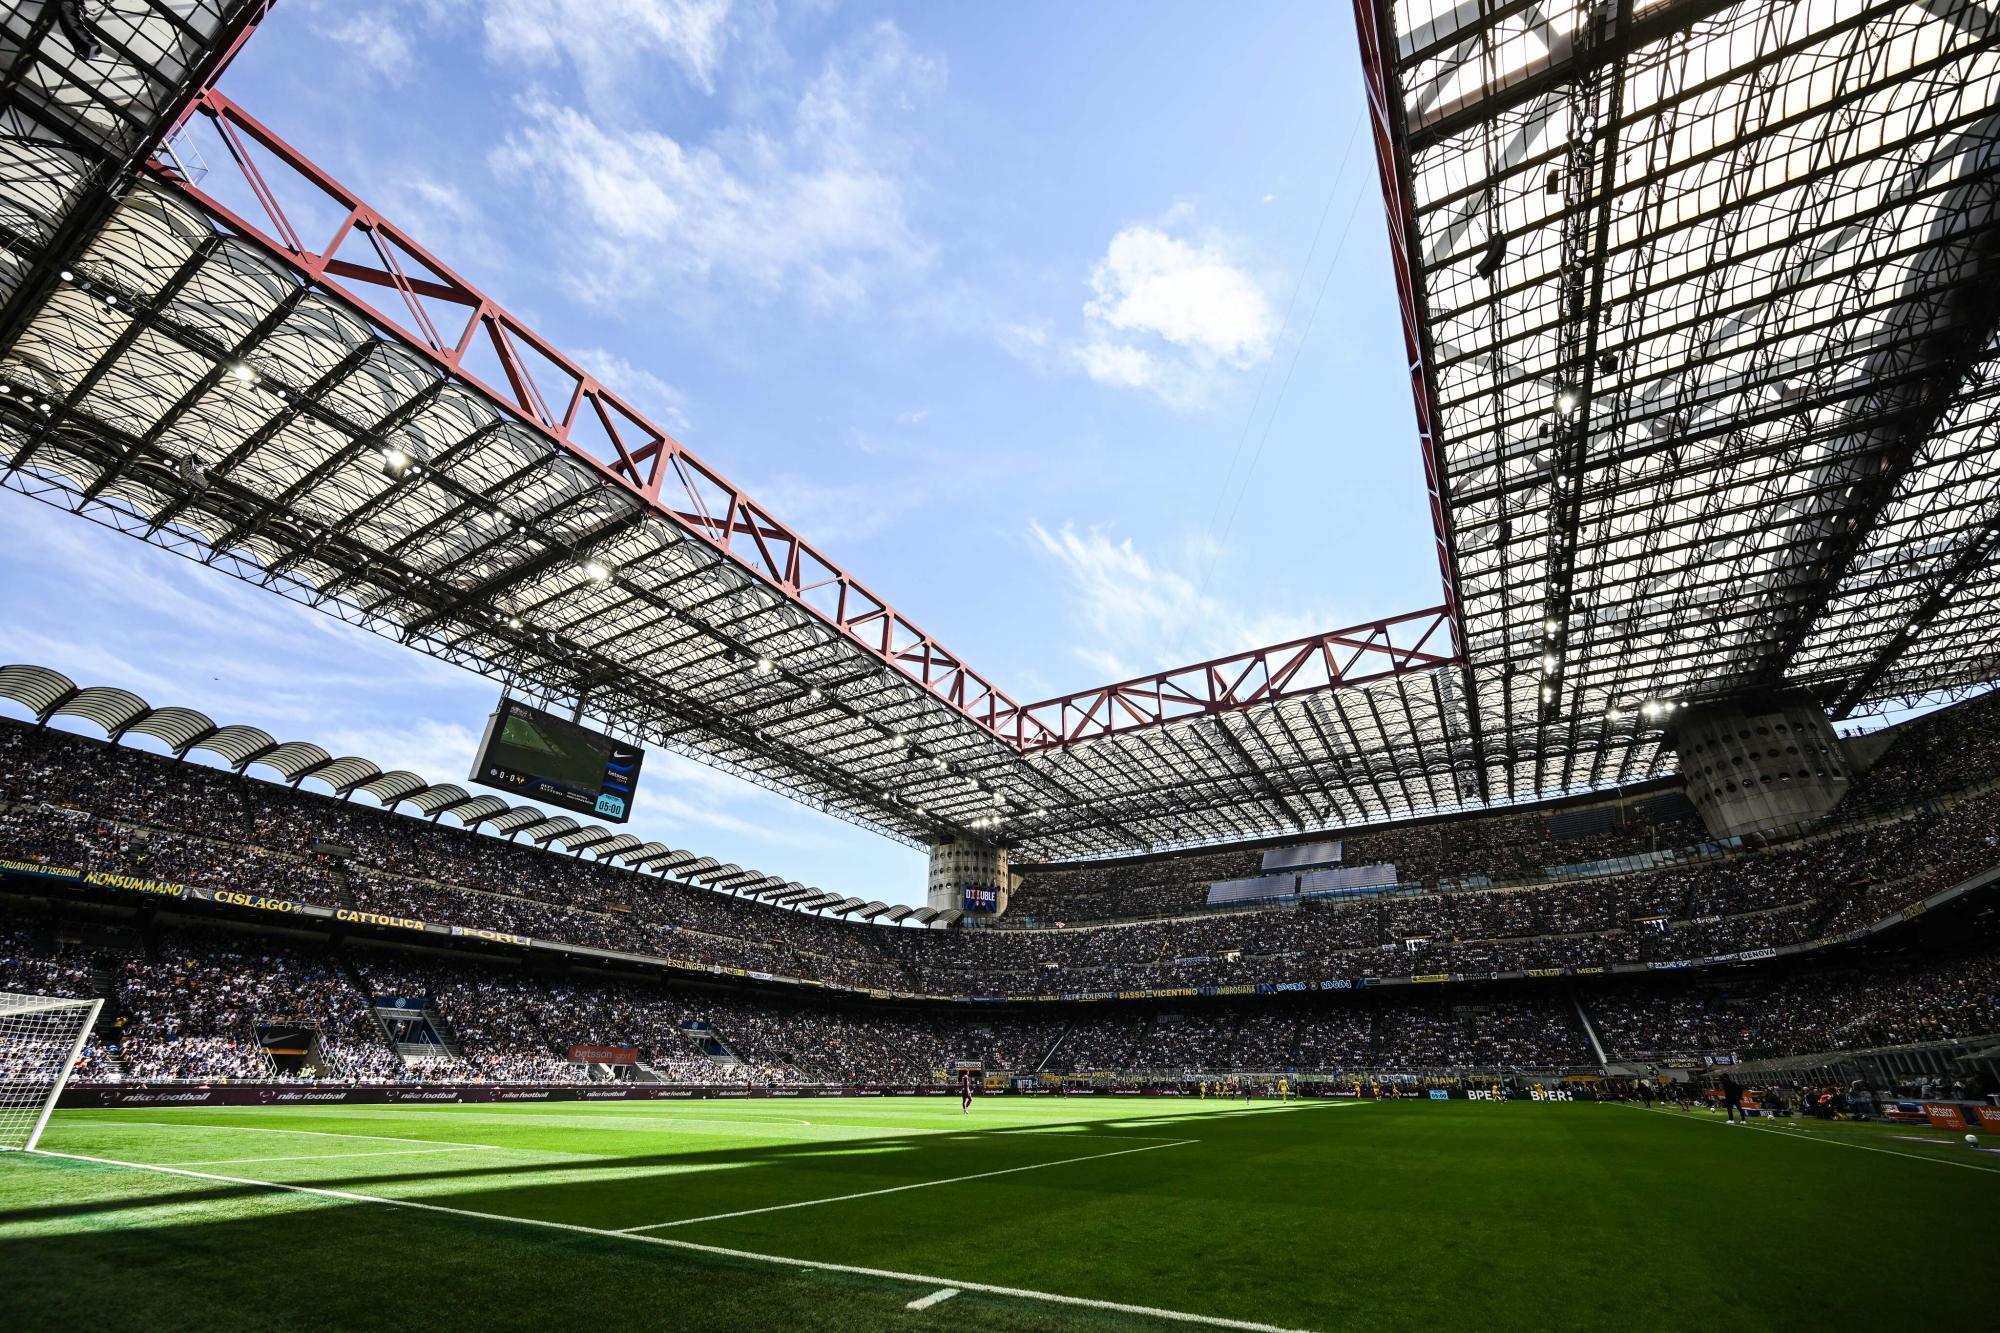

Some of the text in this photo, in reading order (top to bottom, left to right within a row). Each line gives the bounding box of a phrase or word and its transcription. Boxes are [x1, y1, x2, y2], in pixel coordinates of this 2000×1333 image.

[599, 800, 621, 815] 05:00
[40, 865, 81, 879] D'ISERNIA
[83, 871, 184, 896] MONSUMMANO
[214, 890, 292, 912] CISLAGO
[336, 909, 425, 931] CATTOLICA
[1741, 949, 1775, 960] GENOVA
[667, 957, 706, 972] ESSLINGEN
[1577, 966, 1604, 975] MEDE
[1119, 988, 1198, 1000] BASSO VICENTINO
[1217, 985, 1256, 996] AMBROSIANA
[575, 1049, 613, 1059] betsson
[122, 1092, 212, 1101] nike football
[302, 1092, 347, 1100] football
